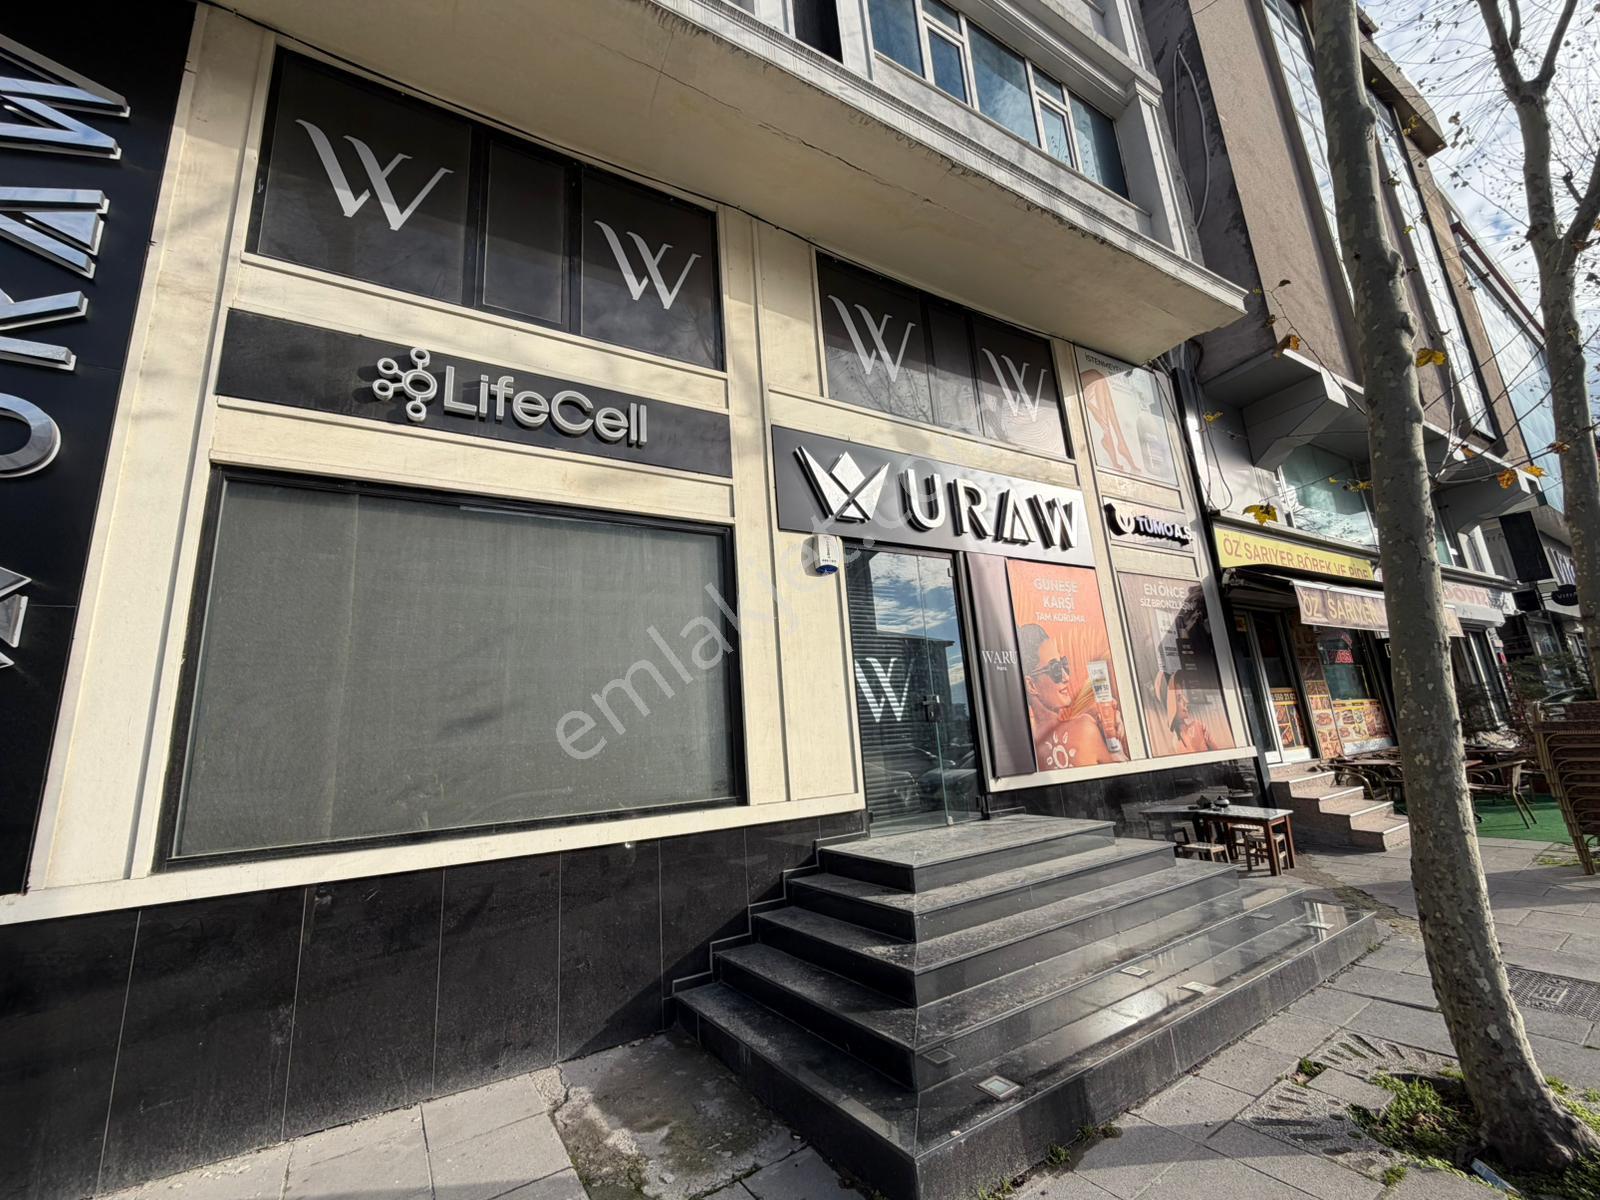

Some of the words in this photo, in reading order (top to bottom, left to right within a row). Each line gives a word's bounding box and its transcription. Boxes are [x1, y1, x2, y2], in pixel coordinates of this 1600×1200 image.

[443, 365, 648, 447] LifeCell
[1223, 534, 1243, 558] ÖZ
[1243, 539, 1294, 567] SARIYER
[1143, 583, 1157, 596] EN
[1303, 592, 1322, 617] ÖZ
